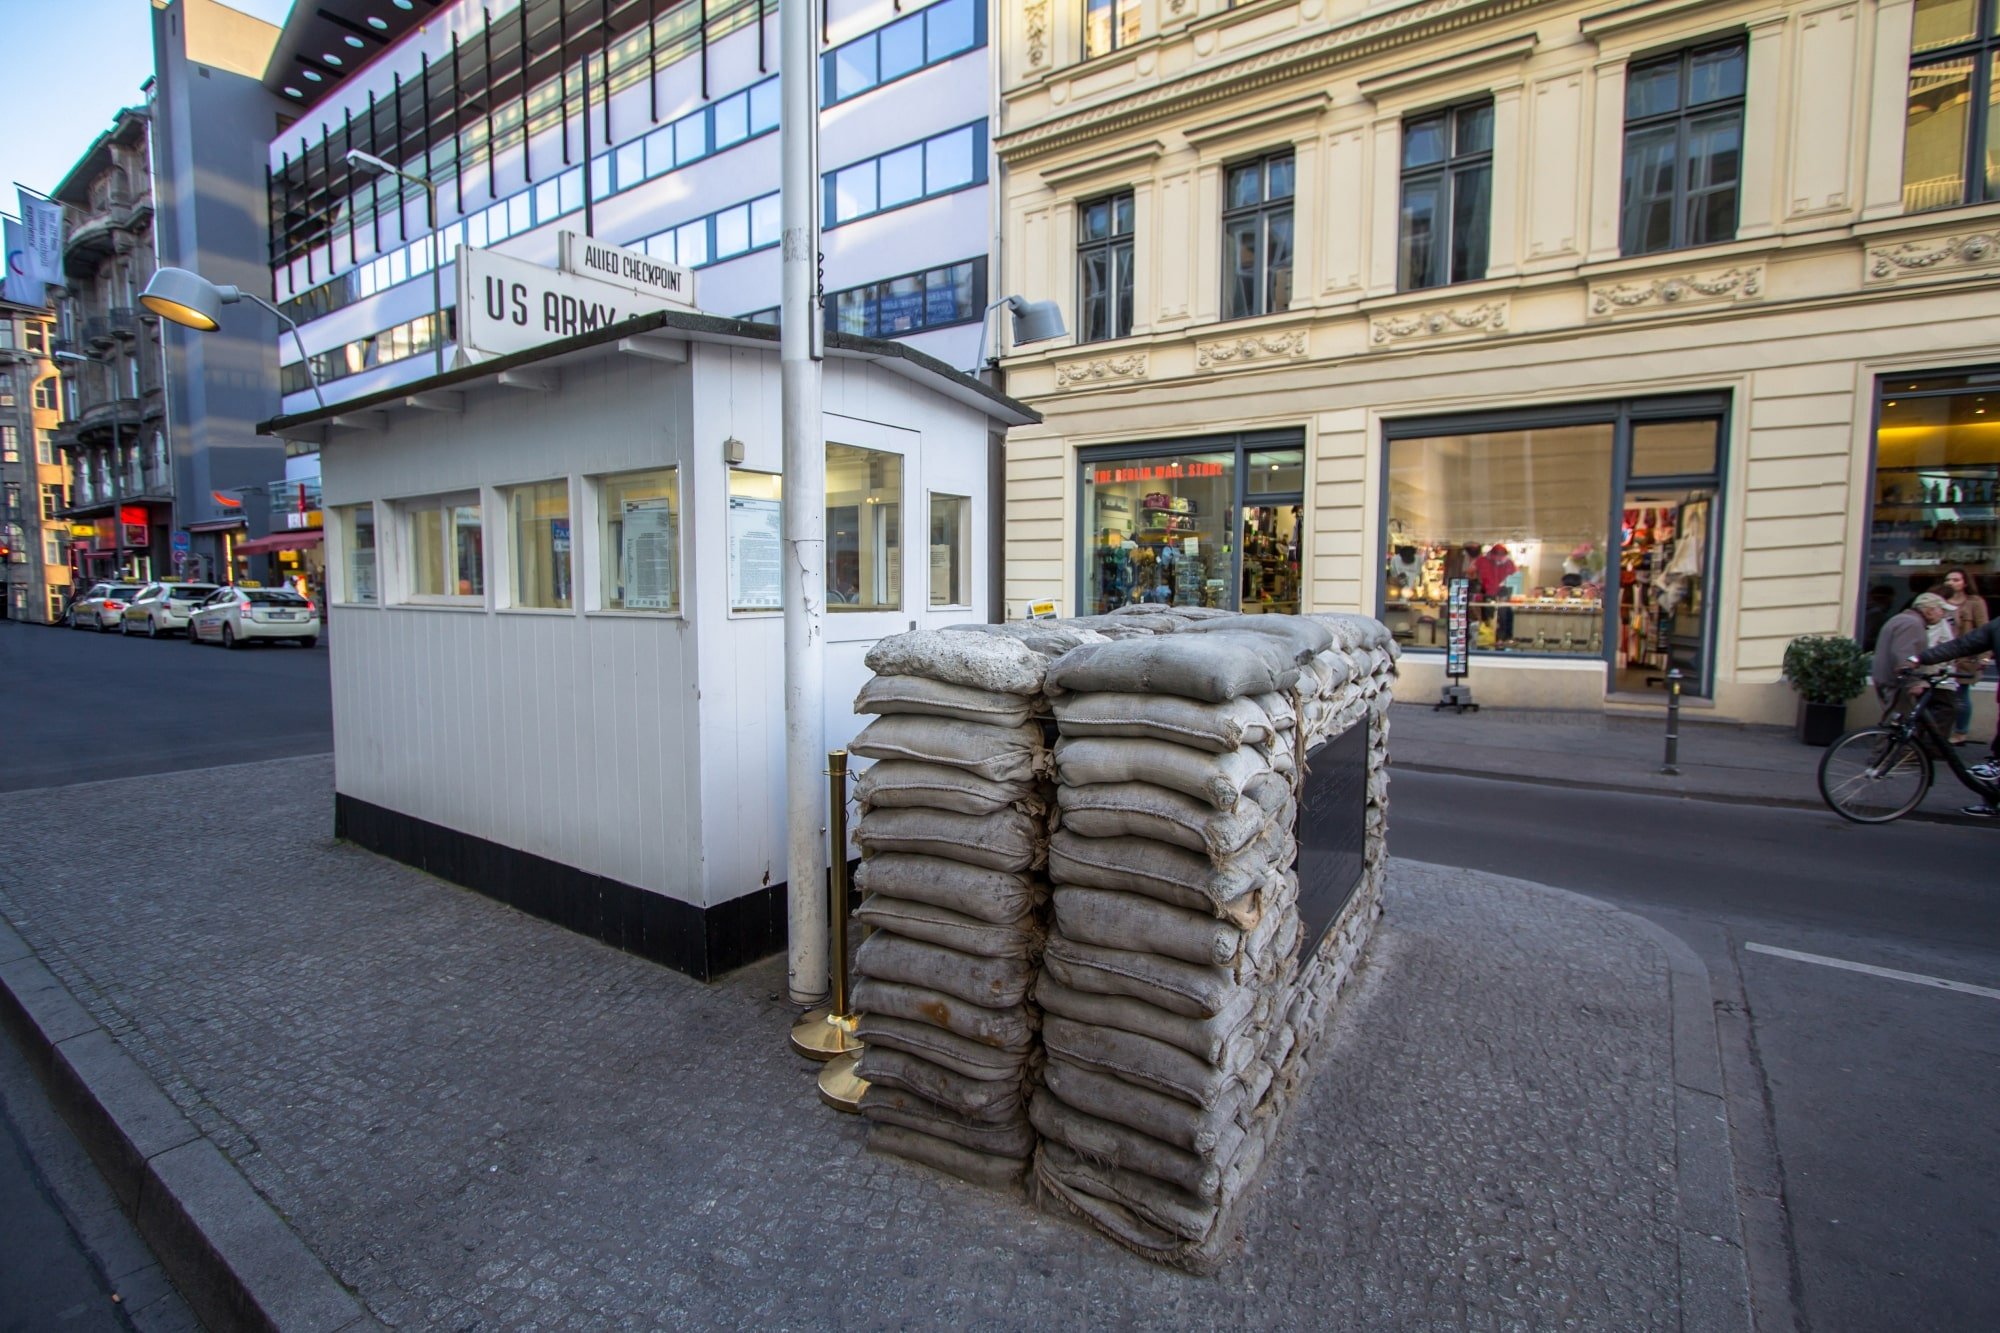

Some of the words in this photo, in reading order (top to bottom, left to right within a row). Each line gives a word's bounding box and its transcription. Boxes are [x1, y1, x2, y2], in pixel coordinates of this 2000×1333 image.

[585, 245, 619, 274] ALLIED
[622, 256, 682, 293] CHECKPOINT
[485, 275, 528, 327] US
[543, 291, 616, 336] ARMY
[1115, 467, 1151, 482] BERLIN
[1155, 464, 1184, 479] WALL
[1188, 463, 1223, 478] STORE
